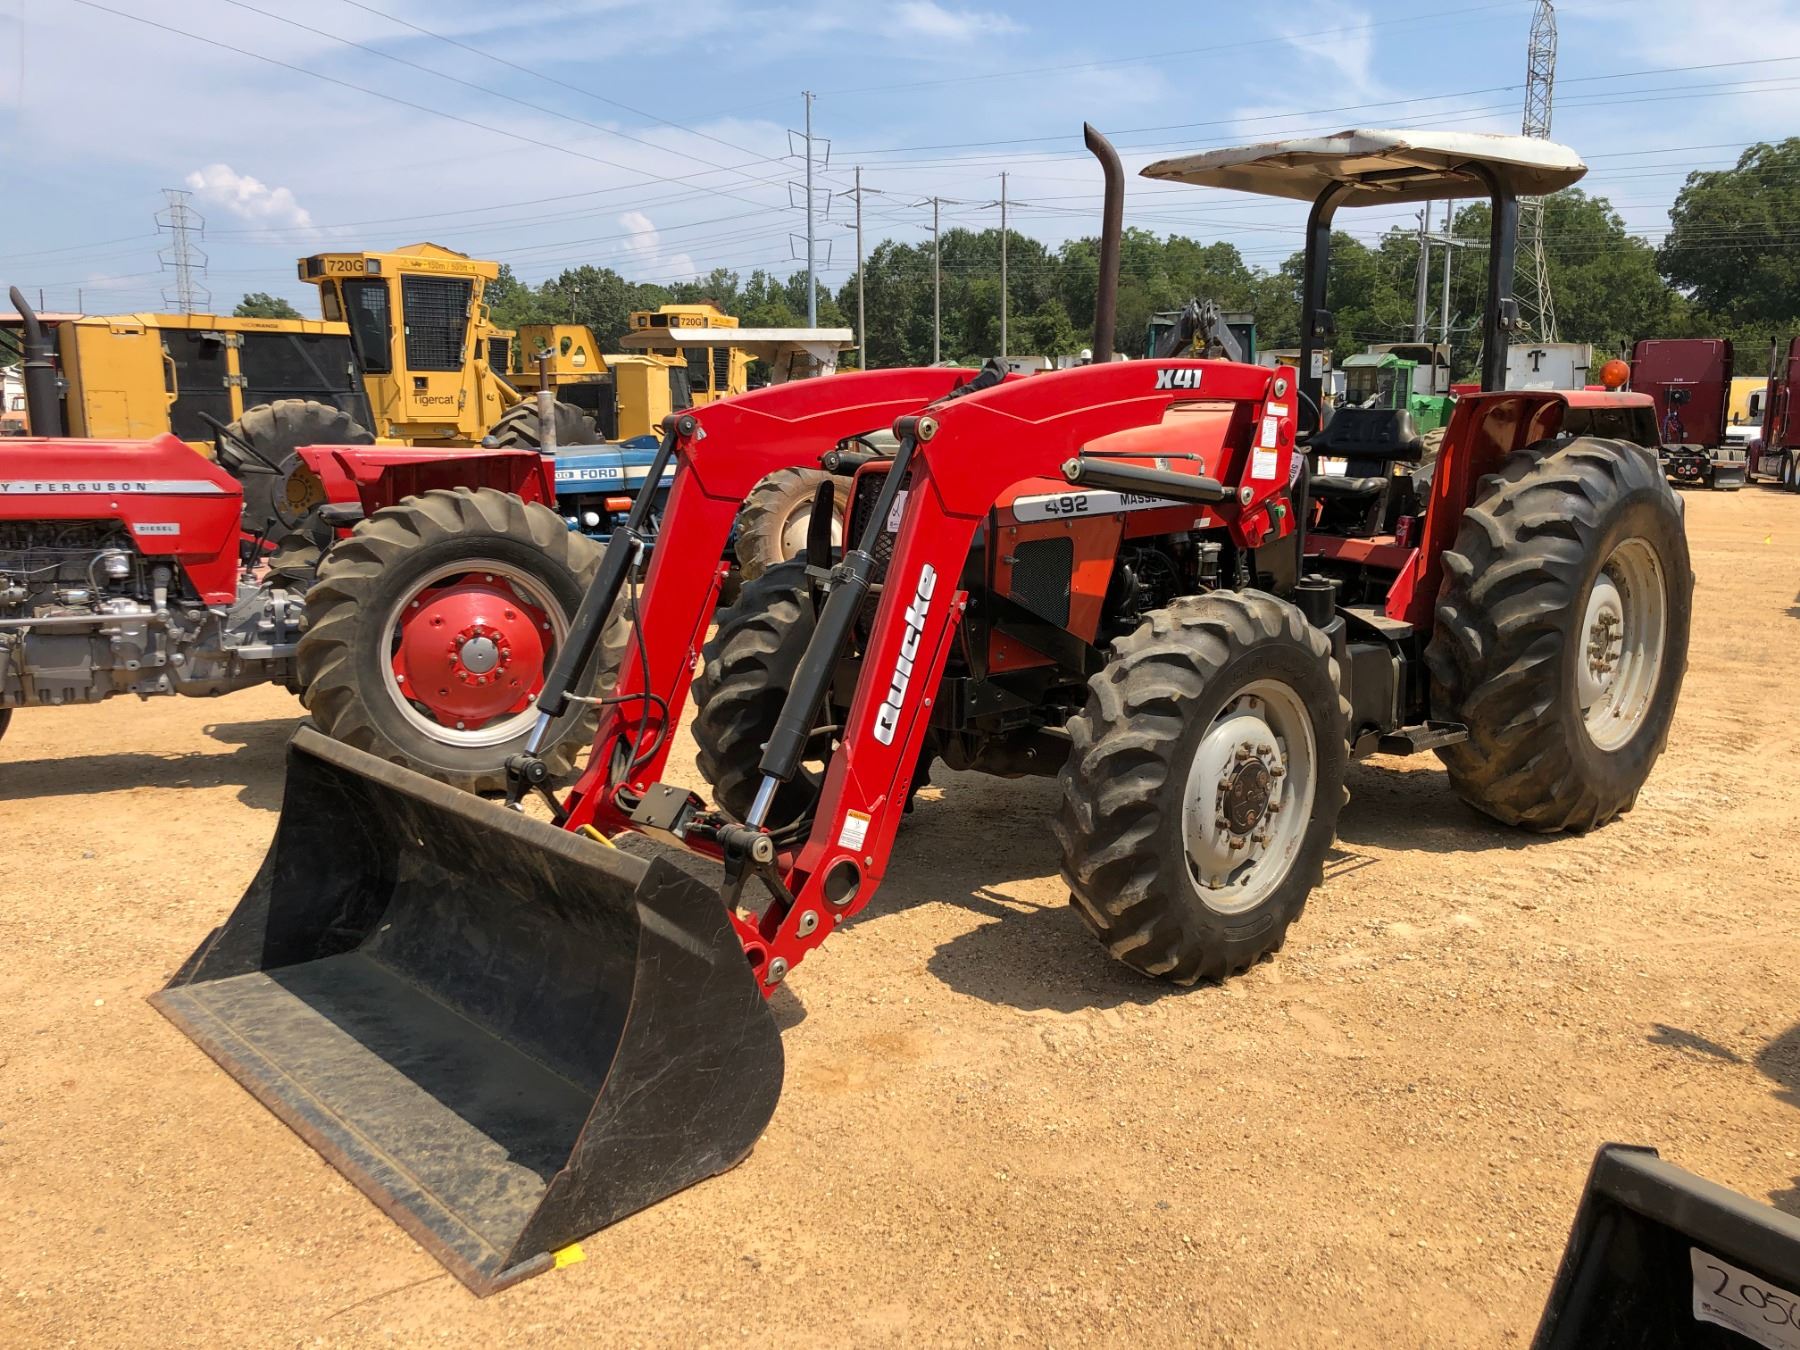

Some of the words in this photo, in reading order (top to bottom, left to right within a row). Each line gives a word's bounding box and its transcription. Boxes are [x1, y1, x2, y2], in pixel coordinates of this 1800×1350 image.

[329, 259, 363, 272] 720G
[681, 318, 701, 326] 720G
[1528, 350, 1546, 372] T
[1155, 369, 1202, 389] X41
[415, 395, 454, 406] Tigercat
[580, 469, 618, 479] FORD
[1045, 495, 1088, 514] 492
